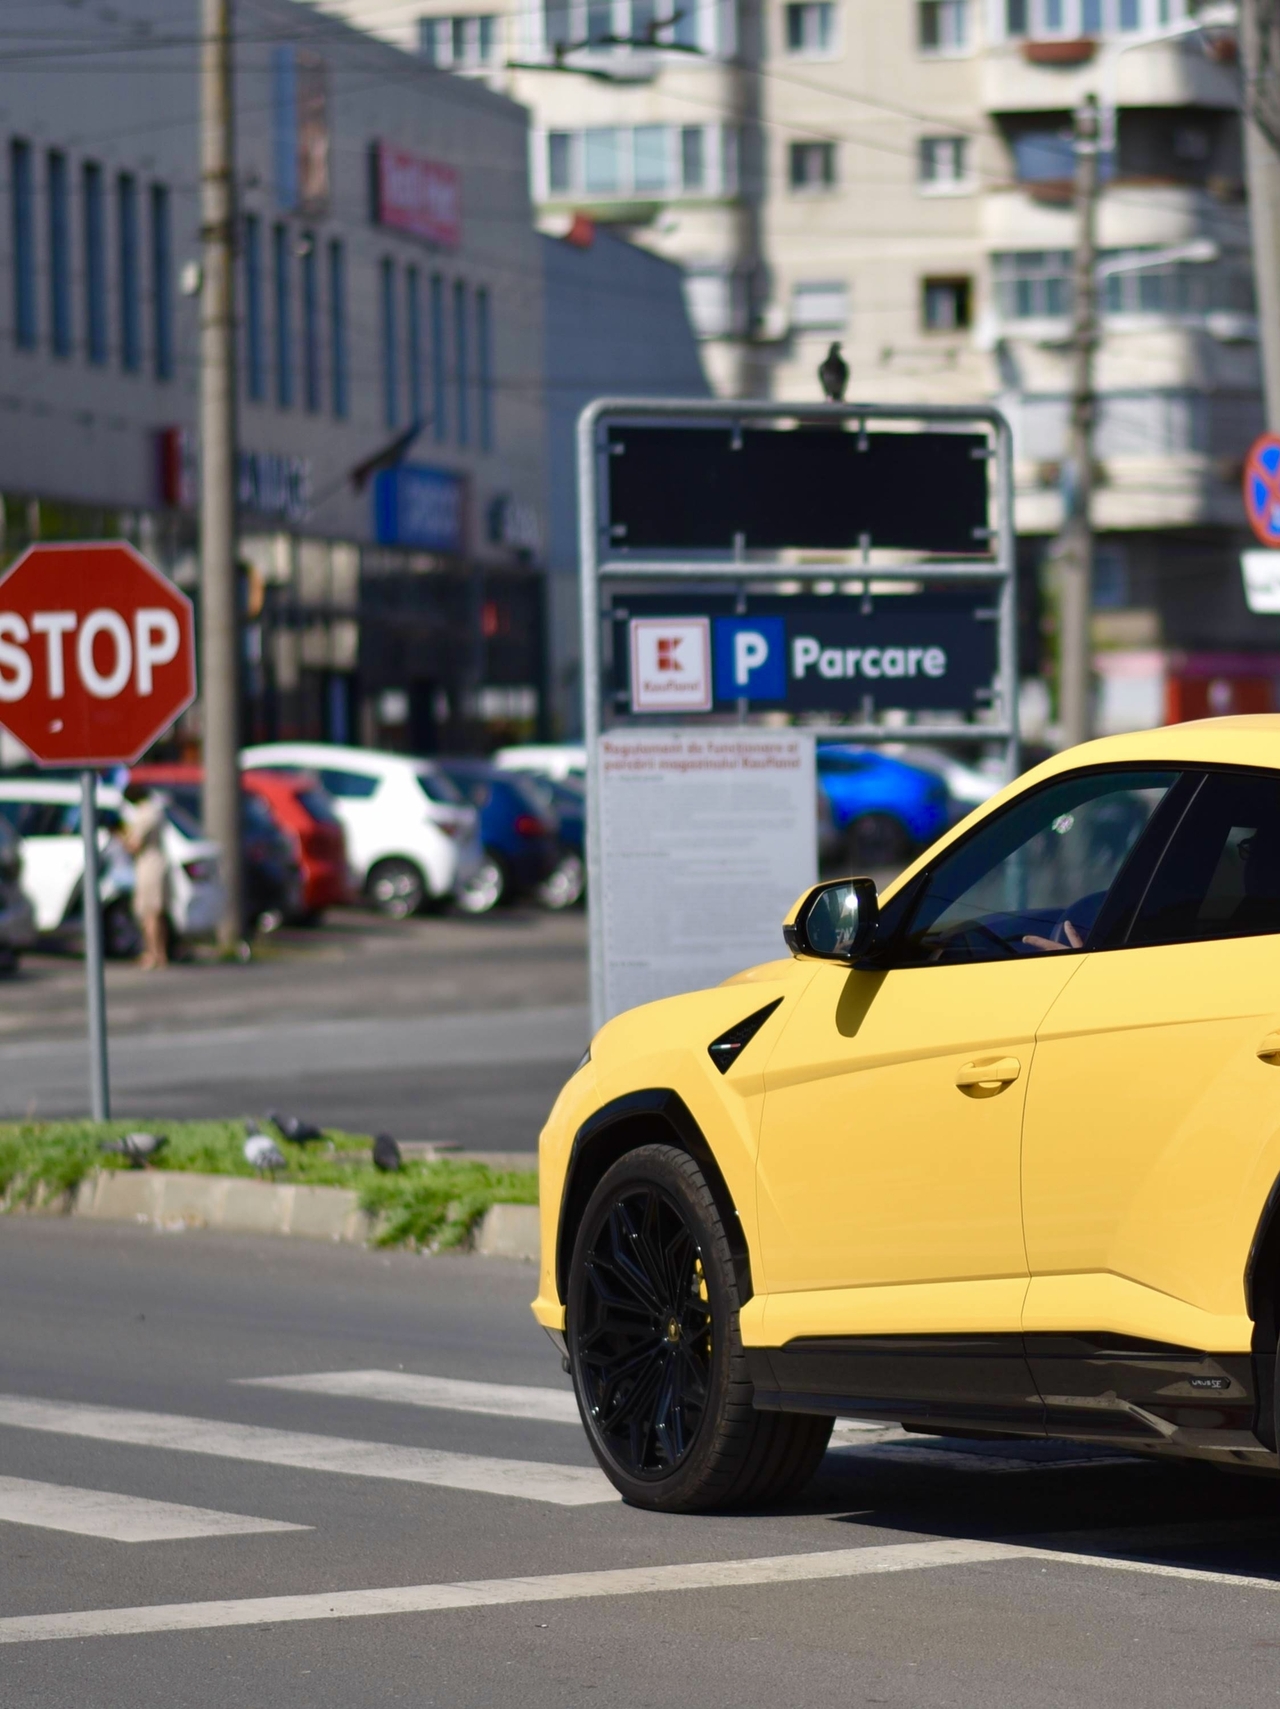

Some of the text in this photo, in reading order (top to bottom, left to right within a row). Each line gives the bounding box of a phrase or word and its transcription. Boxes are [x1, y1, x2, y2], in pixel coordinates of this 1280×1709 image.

[0, 610, 181, 702] STOP
[734, 632, 768, 685] P
[793, 638, 946, 679] Parcare
